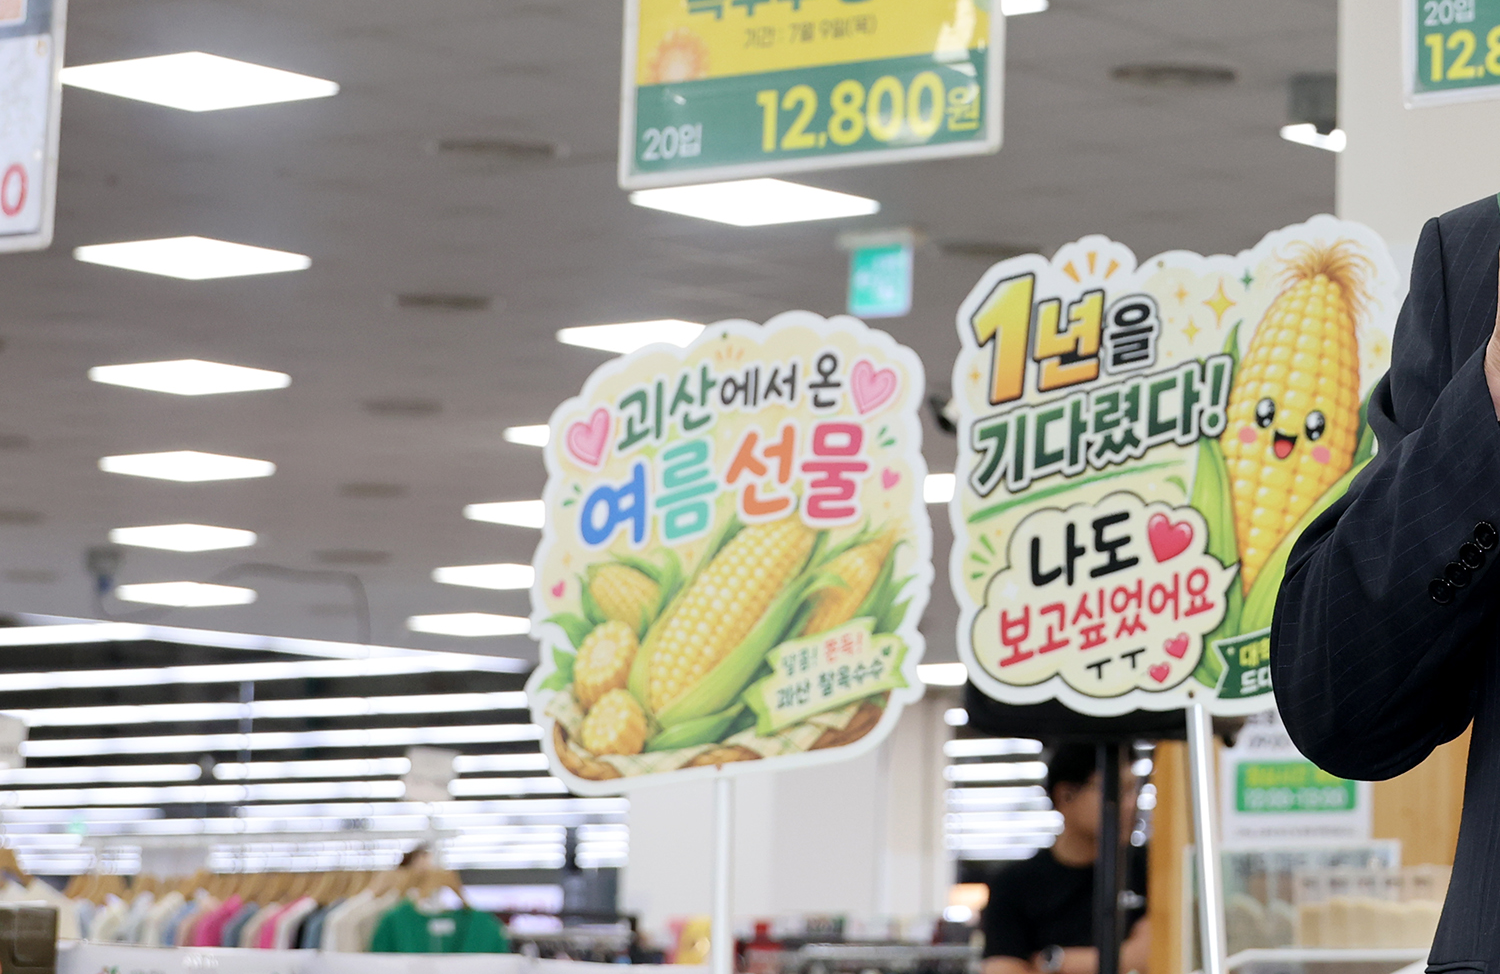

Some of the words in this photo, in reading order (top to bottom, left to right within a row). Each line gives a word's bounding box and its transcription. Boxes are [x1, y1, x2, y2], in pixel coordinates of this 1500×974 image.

[755, 70, 981, 152] 12,800원
[971, 272, 1155, 405] 1년을
[617, 363, 796, 451] 괴산에서
[808, 351, 841, 409] 온
[974, 363, 1227, 488] 기다렸다!
[579, 438, 719, 546] 여름
[724, 422, 869, 520] 선물
[1029, 511, 1139, 588] 나도
[999, 566, 1215, 669] 보고싶었어요
